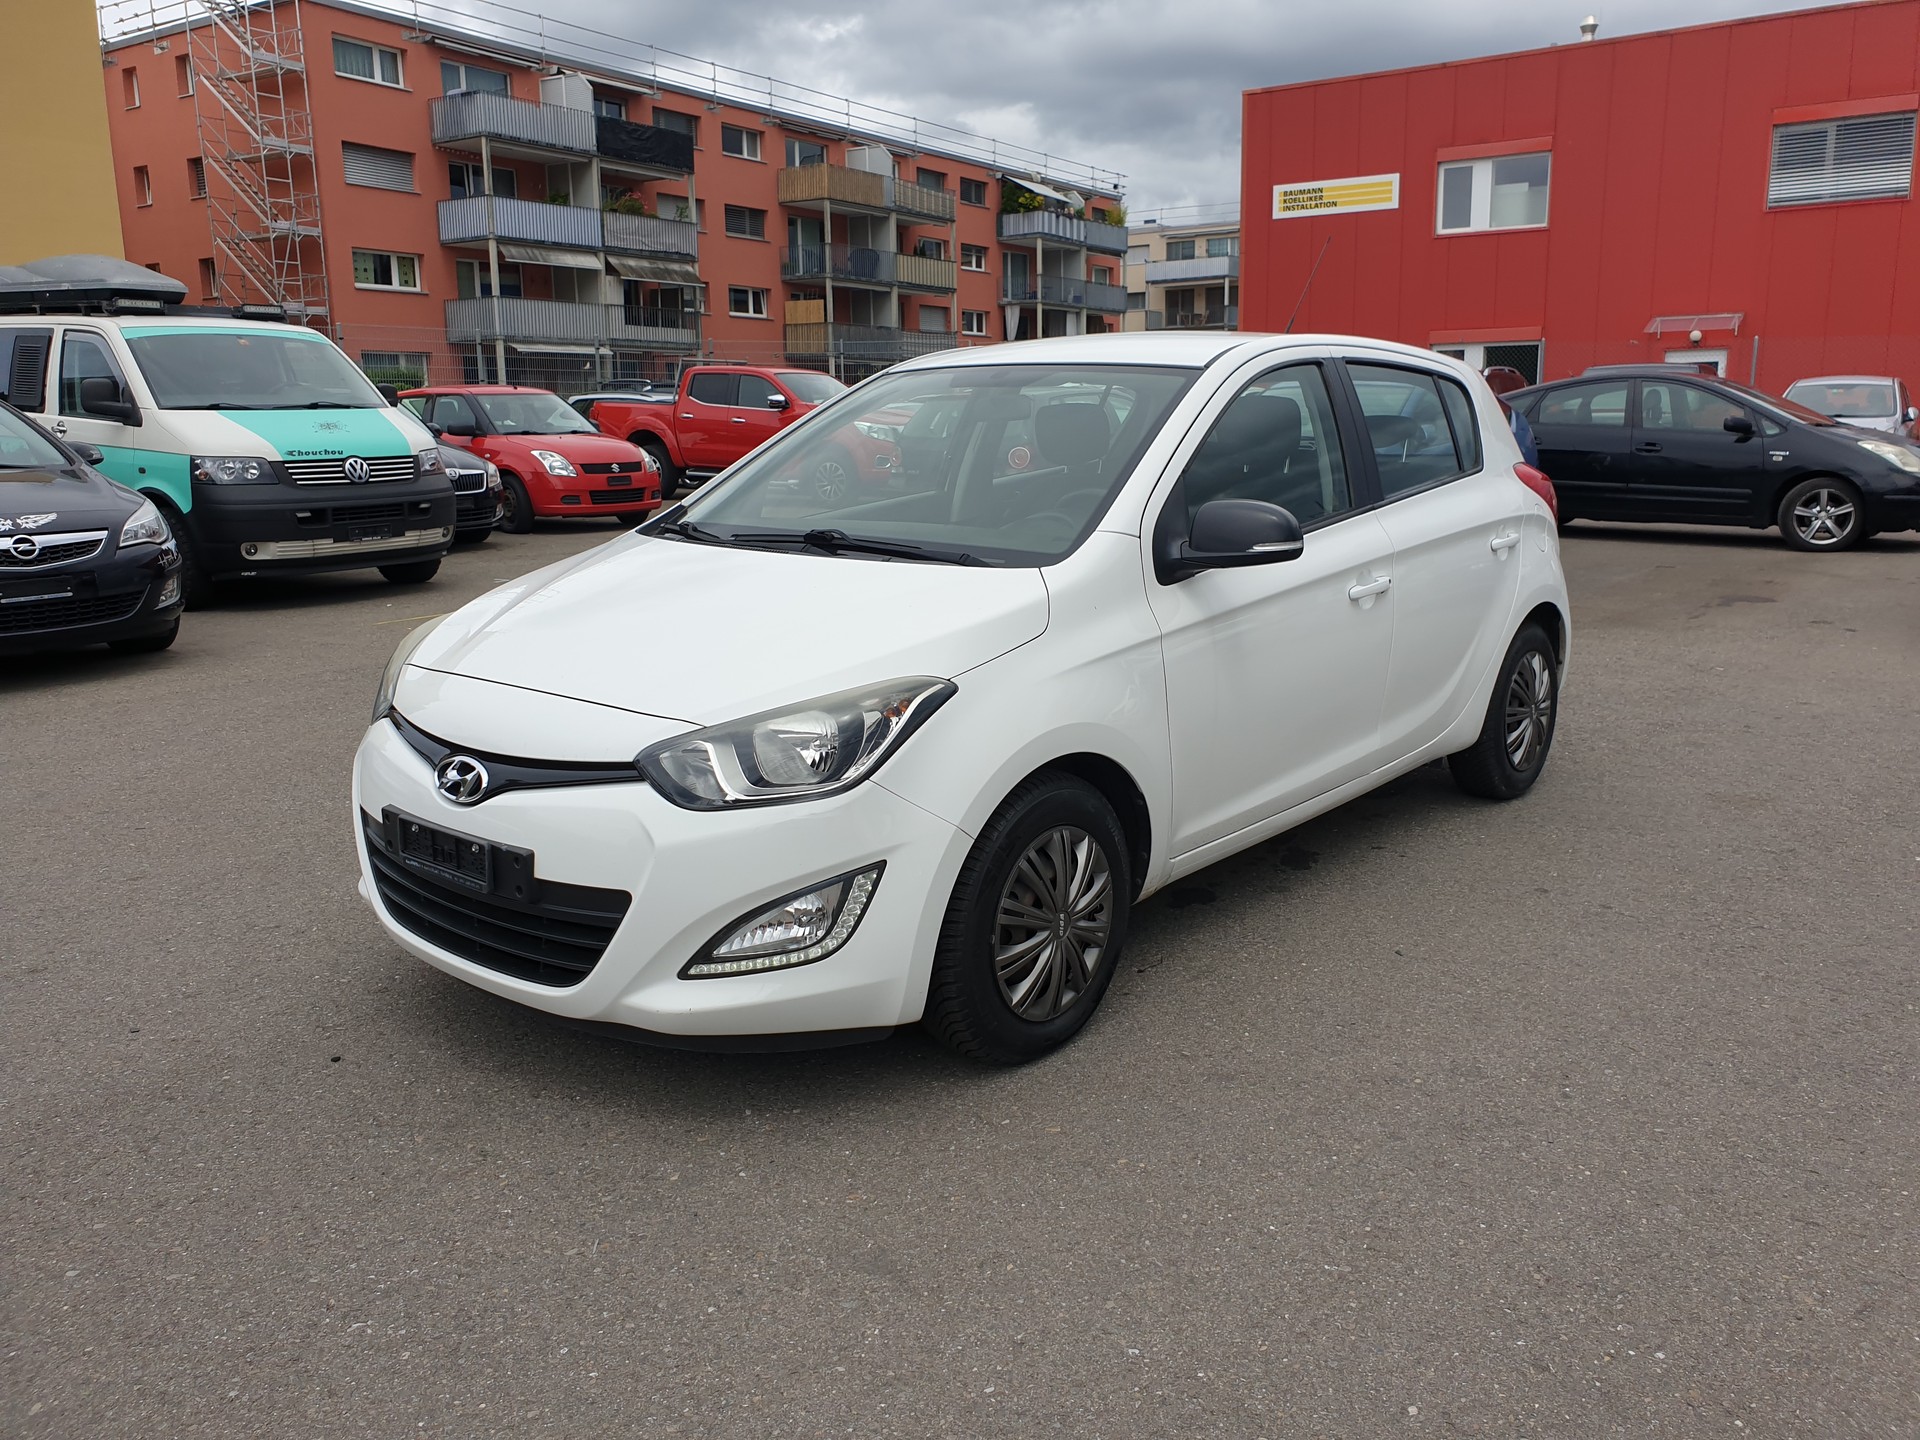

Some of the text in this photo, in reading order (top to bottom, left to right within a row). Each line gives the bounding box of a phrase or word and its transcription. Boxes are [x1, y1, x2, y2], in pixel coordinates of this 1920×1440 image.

[1283, 188, 1323, 197] BAUMANN
[1283, 195, 1324, 204] KOELLIKER
[1283, 201, 1337, 211] INSTALLATION
